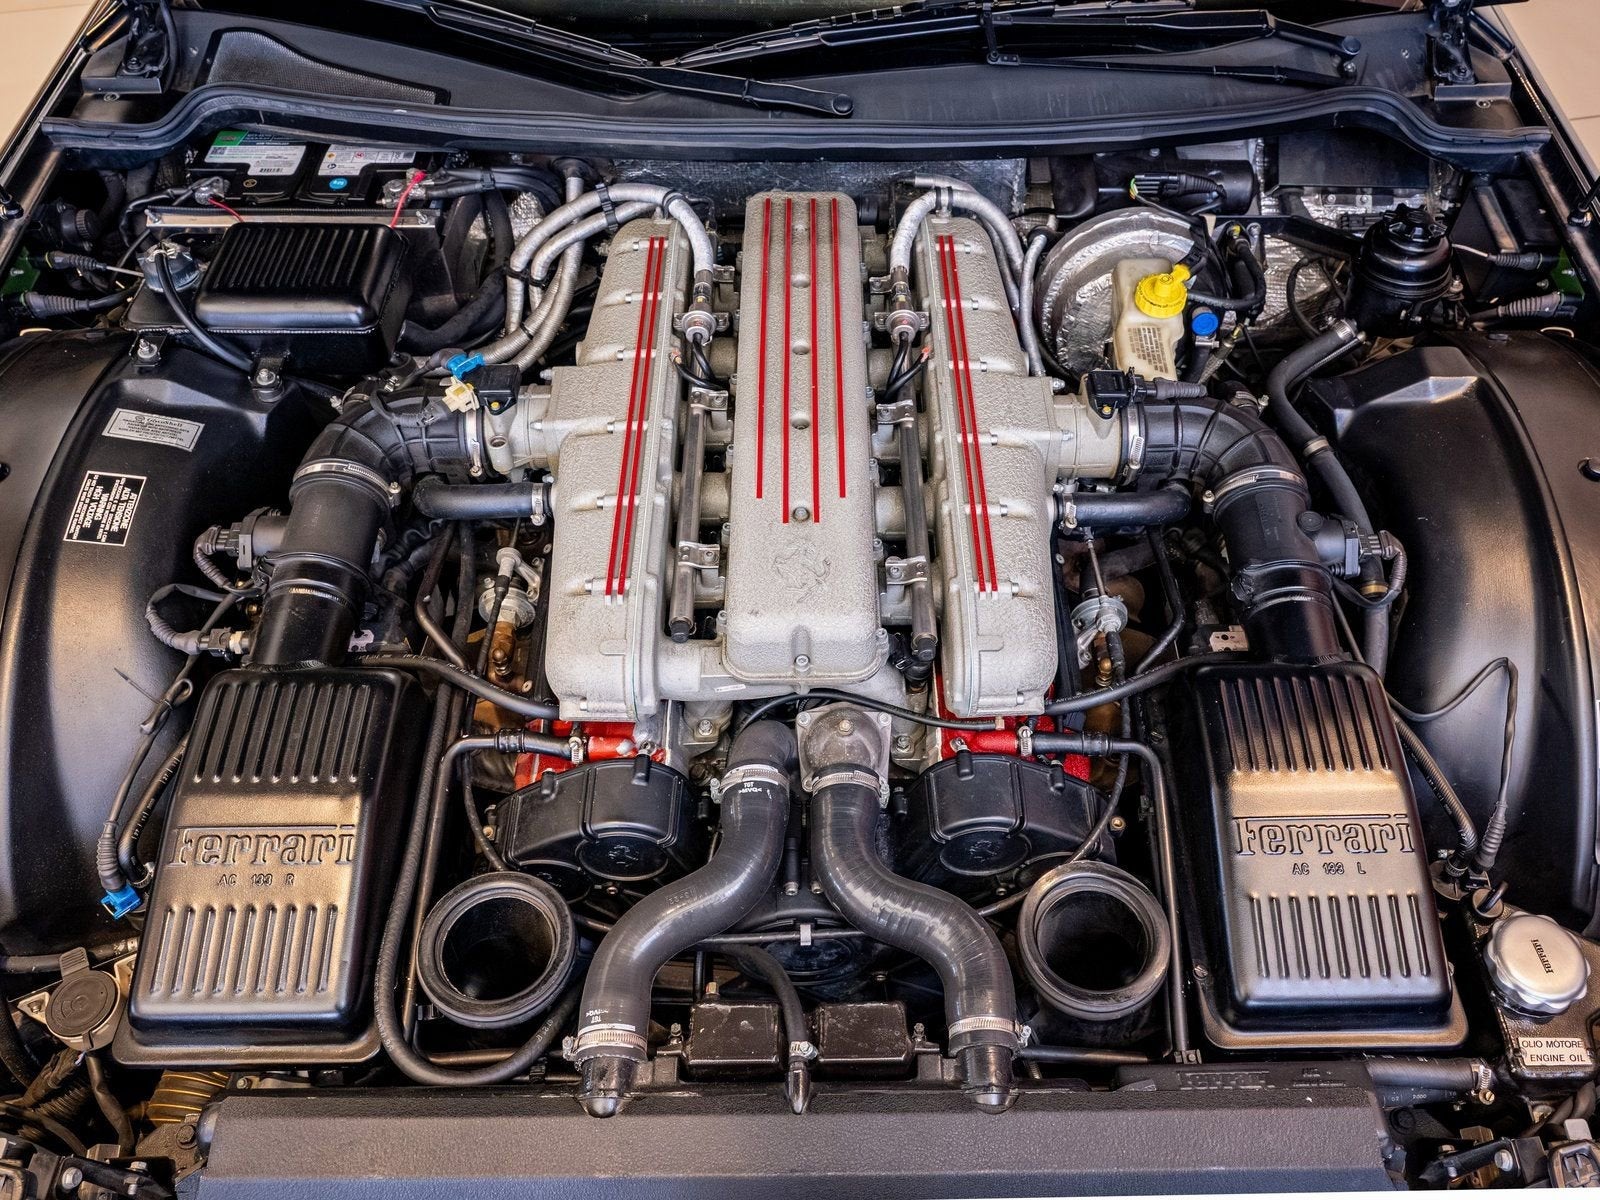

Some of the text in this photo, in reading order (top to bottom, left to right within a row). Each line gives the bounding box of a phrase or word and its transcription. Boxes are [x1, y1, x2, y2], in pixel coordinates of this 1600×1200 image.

[120, 487, 131, 500] ALTA
[120, 492, 138, 530] ATTENZIONE
[1232, 814, 1416, 856] Ferrari
[168, 824, 355, 868] Ferrari
[1292, 861, 1366, 875] AC 133 L
[218, 872, 295, 887] AC 133 R
[1530, 939, 1554, 974] Ferrari
[1521, 1040, 1583, 1048] OLIO MOTORE
[1530, 1054, 1586, 1062] ENGINE OIL
